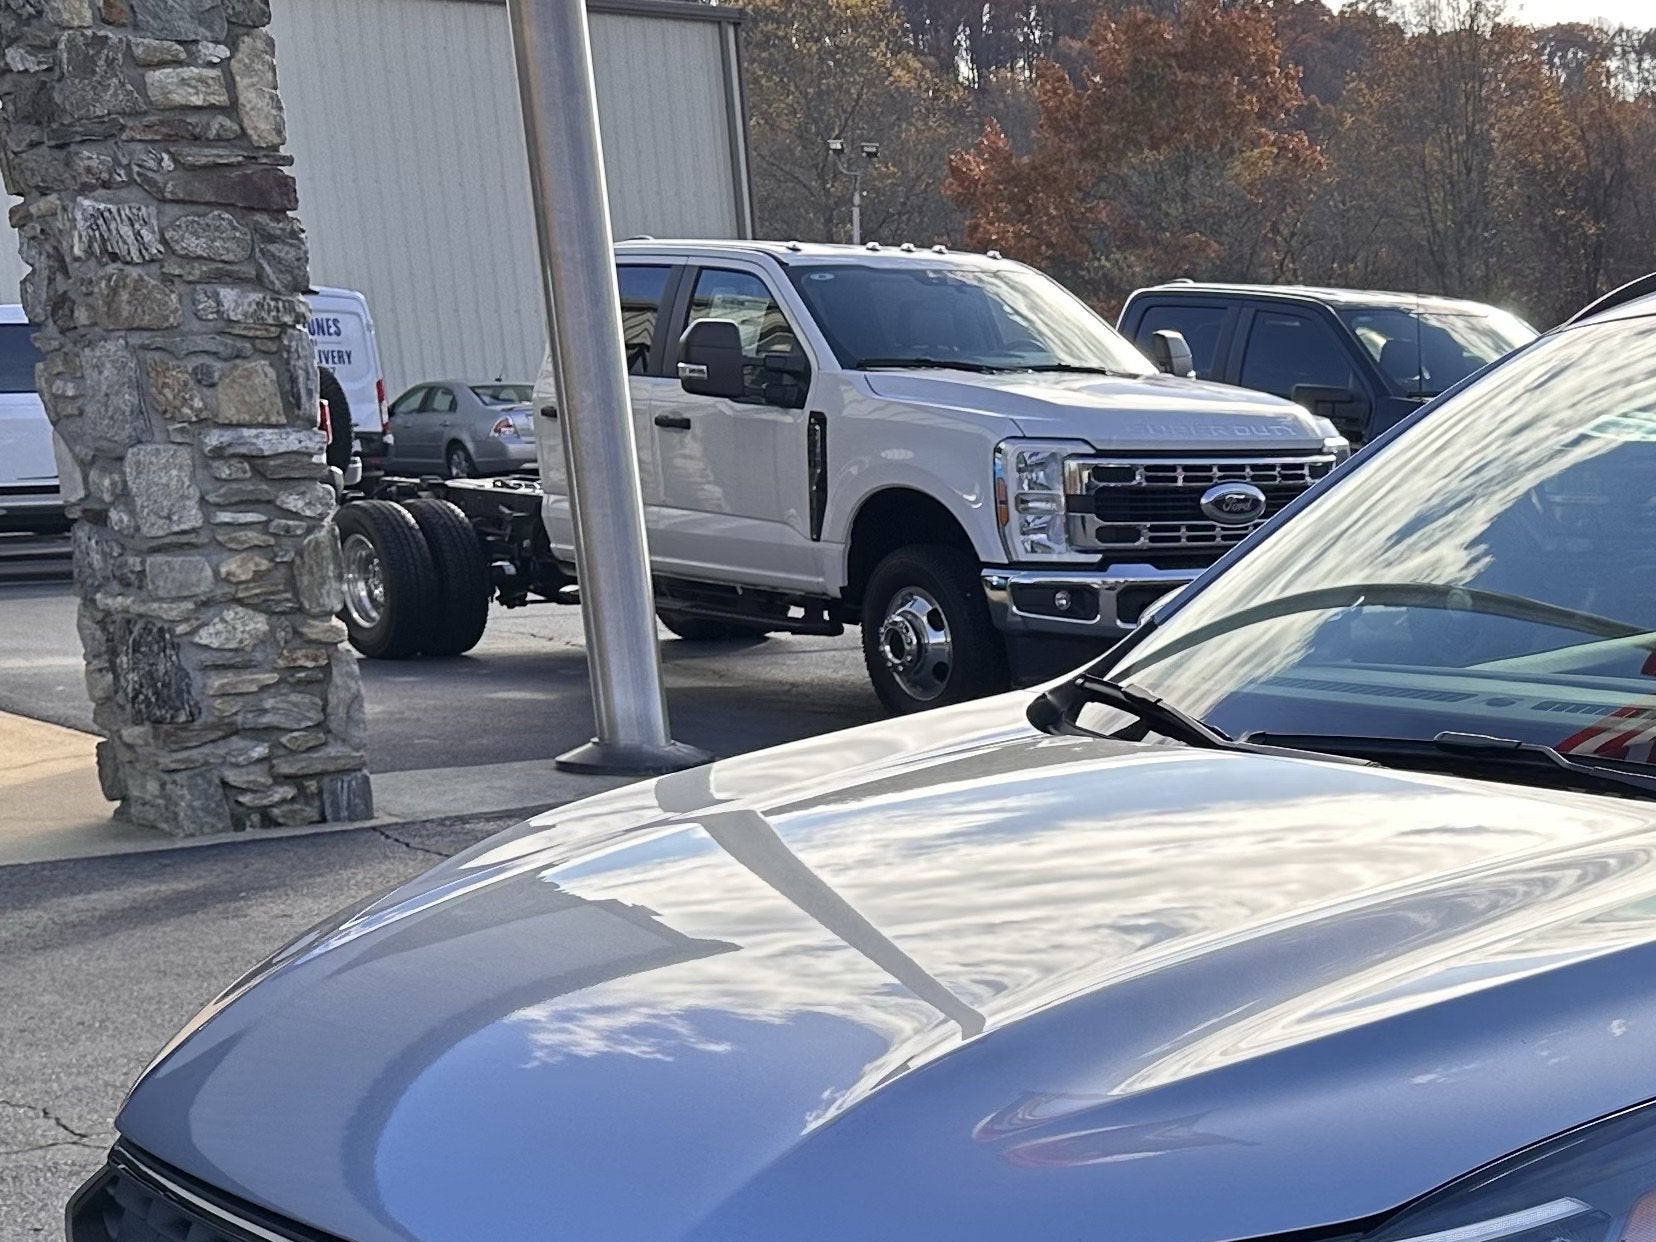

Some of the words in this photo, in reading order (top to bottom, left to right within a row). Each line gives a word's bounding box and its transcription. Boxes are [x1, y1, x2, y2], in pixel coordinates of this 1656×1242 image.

[303, 317, 342, 336] ONES
[317, 349, 352, 365] IVERY
[1231, 425, 1296, 436] DUTY
[1222, 493, 1252, 513] Ford
